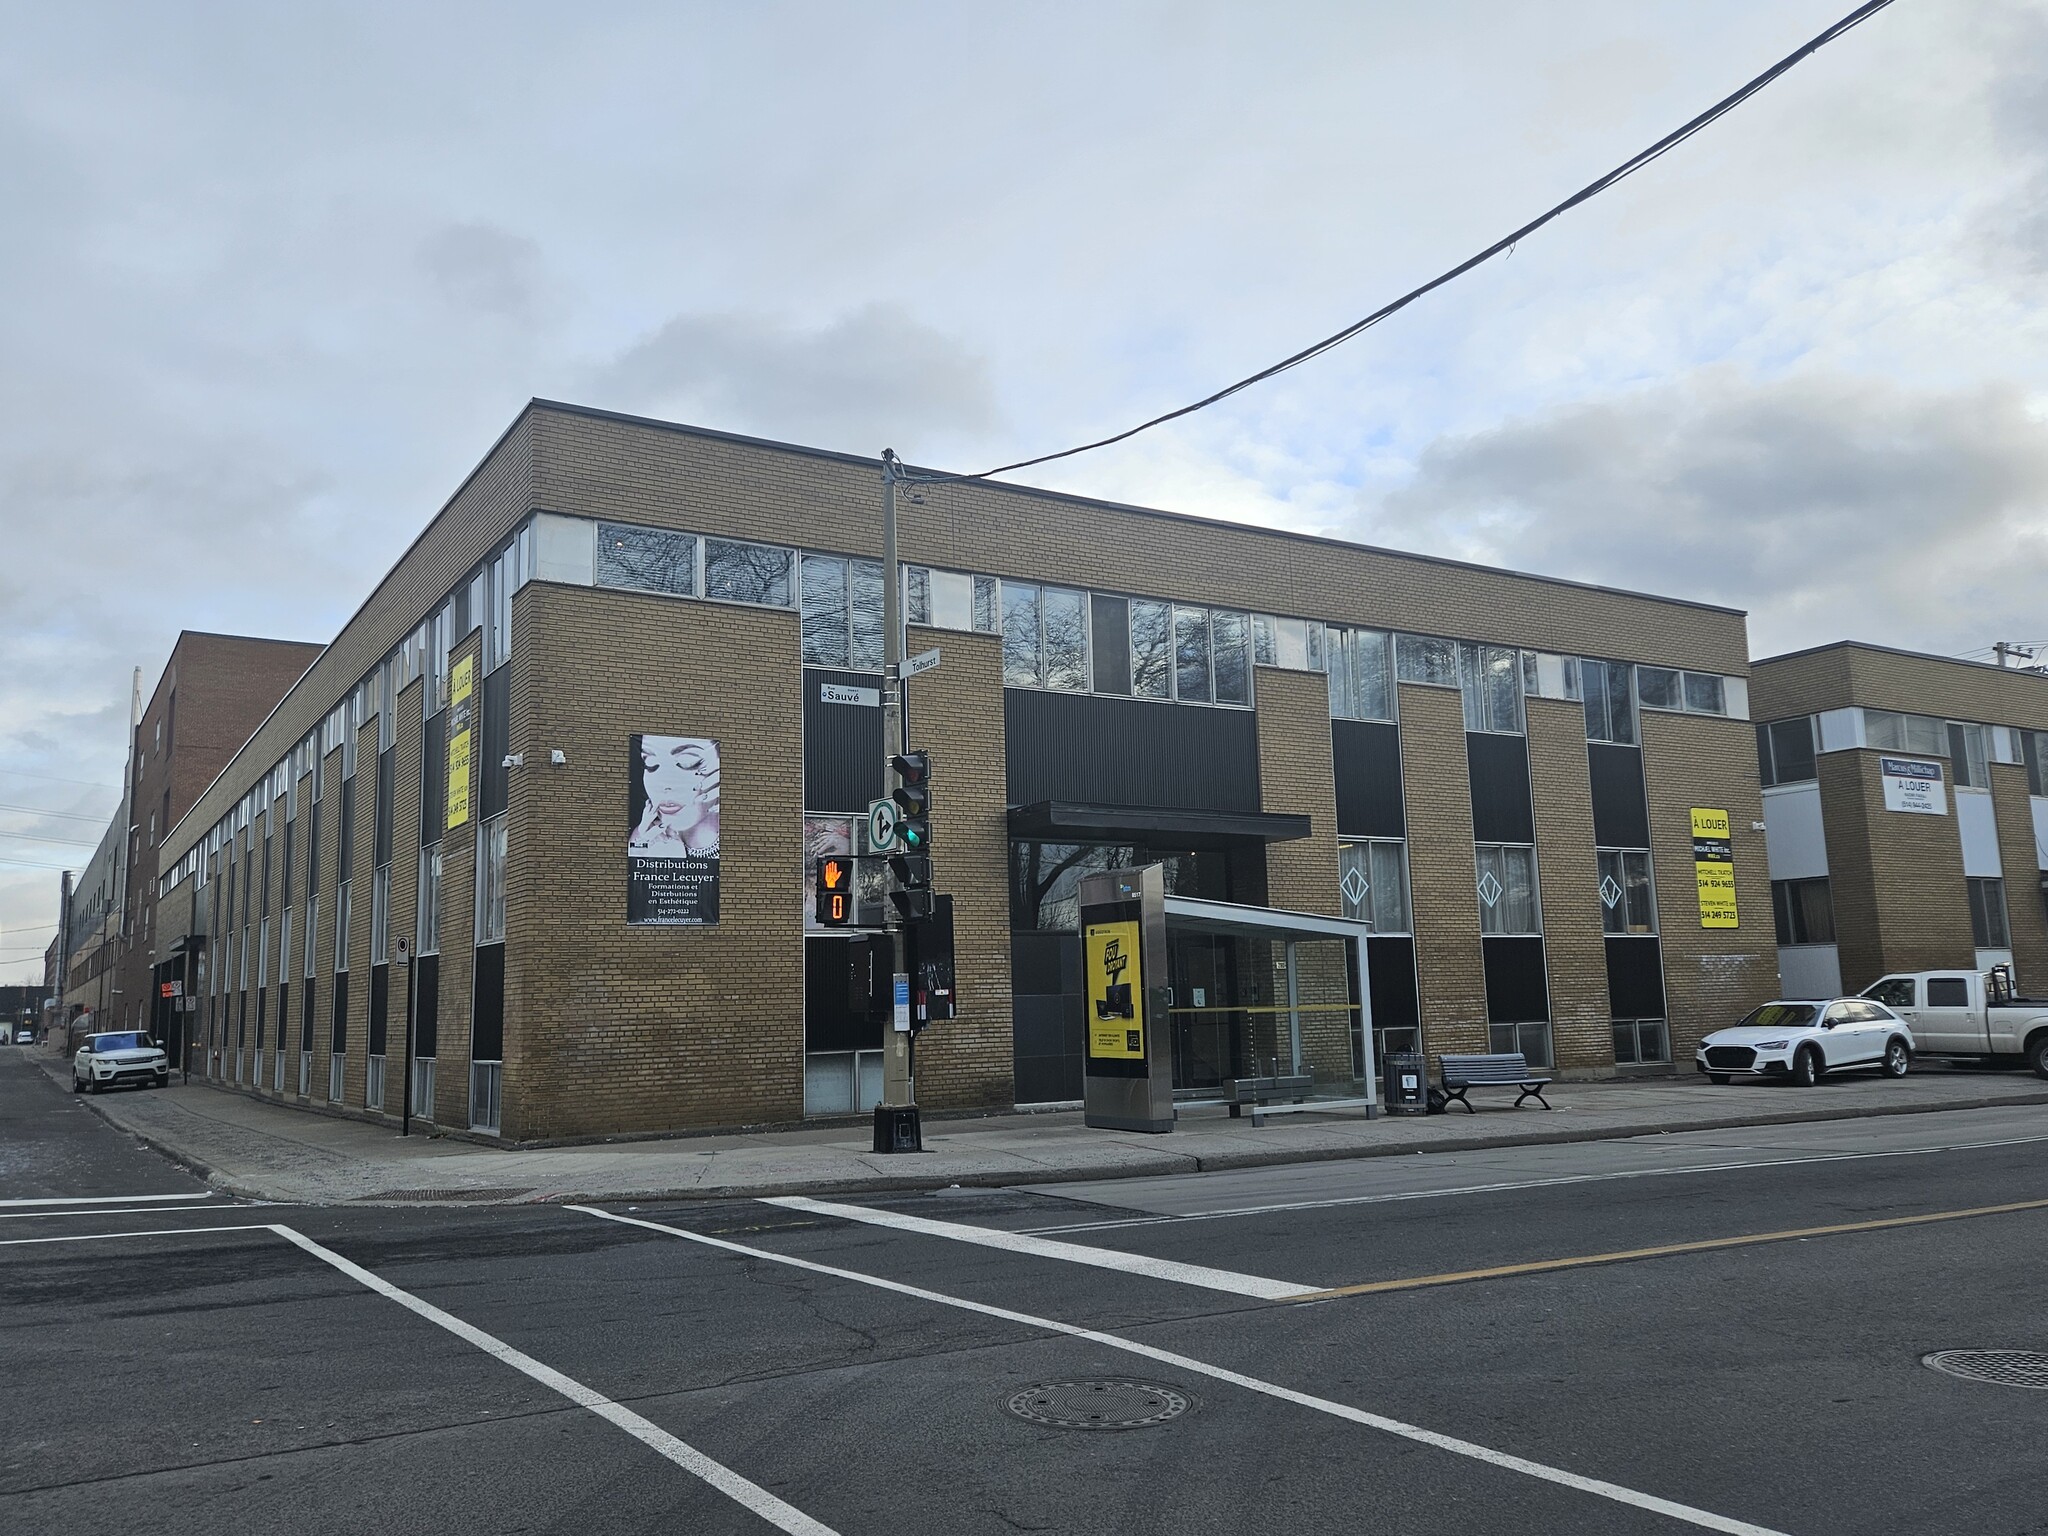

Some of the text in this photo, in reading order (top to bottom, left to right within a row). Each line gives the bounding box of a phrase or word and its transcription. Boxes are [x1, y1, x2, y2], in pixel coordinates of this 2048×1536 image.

[912, 657, 936, 672] Tolhurst
[828, 690, 860, 702] Sauvé
[1905, 781, 1931, 792] LOUER
[1693, 815, 1728, 830] À LOUER
[636, 858, 708, 870] Distributions
[633, 871, 715, 884] France Lecuyer
[1698, 879, 1709, 887] 514
[1710, 880, 1721, 888] 924
[659, 898, 699, 906] Esthétique
[832, 895, 843, 919] 0
[643, 916, 703, 924] www.francelecuyer.com
[1701, 910, 1711, 919] 514
